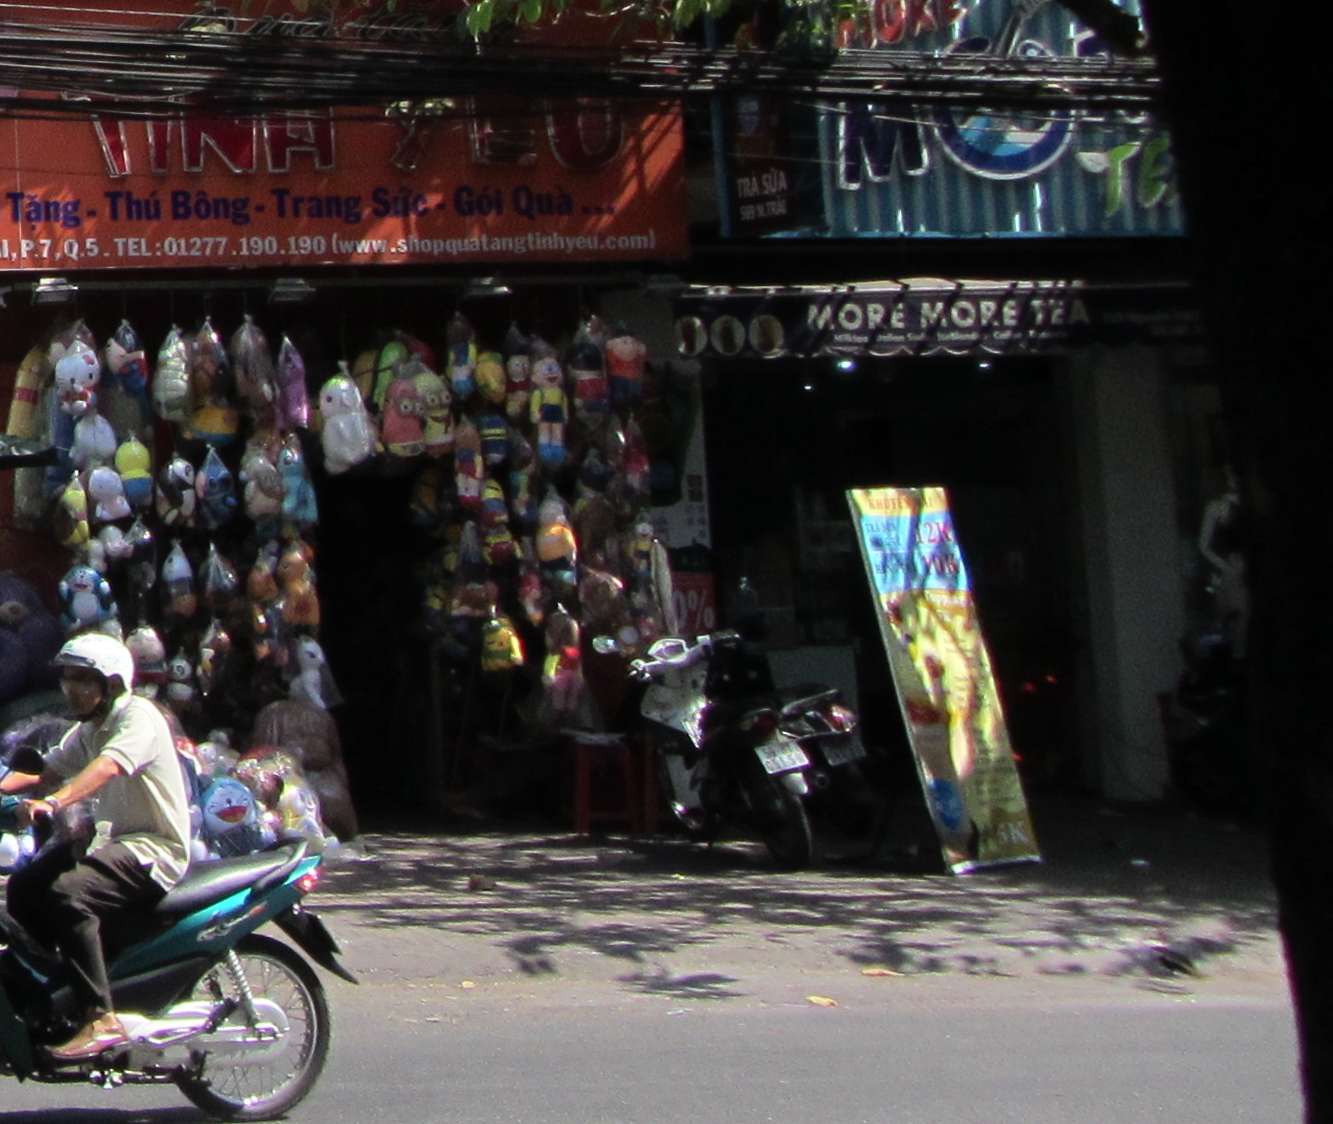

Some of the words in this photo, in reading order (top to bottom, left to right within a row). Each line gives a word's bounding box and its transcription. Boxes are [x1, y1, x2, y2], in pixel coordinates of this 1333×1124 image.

[6, 191, 82, 230] Tặng
[104, 190, 162, 221] Thú
[171, 189, 251, 226] Bông
[271, 188, 362, 224] Trang
[371, 185, 428, 218] Sức
[453, 184, 503, 217] Gói
[512, 184, 573, 220] Quà
[919, 299, 1019, 328] MORE
